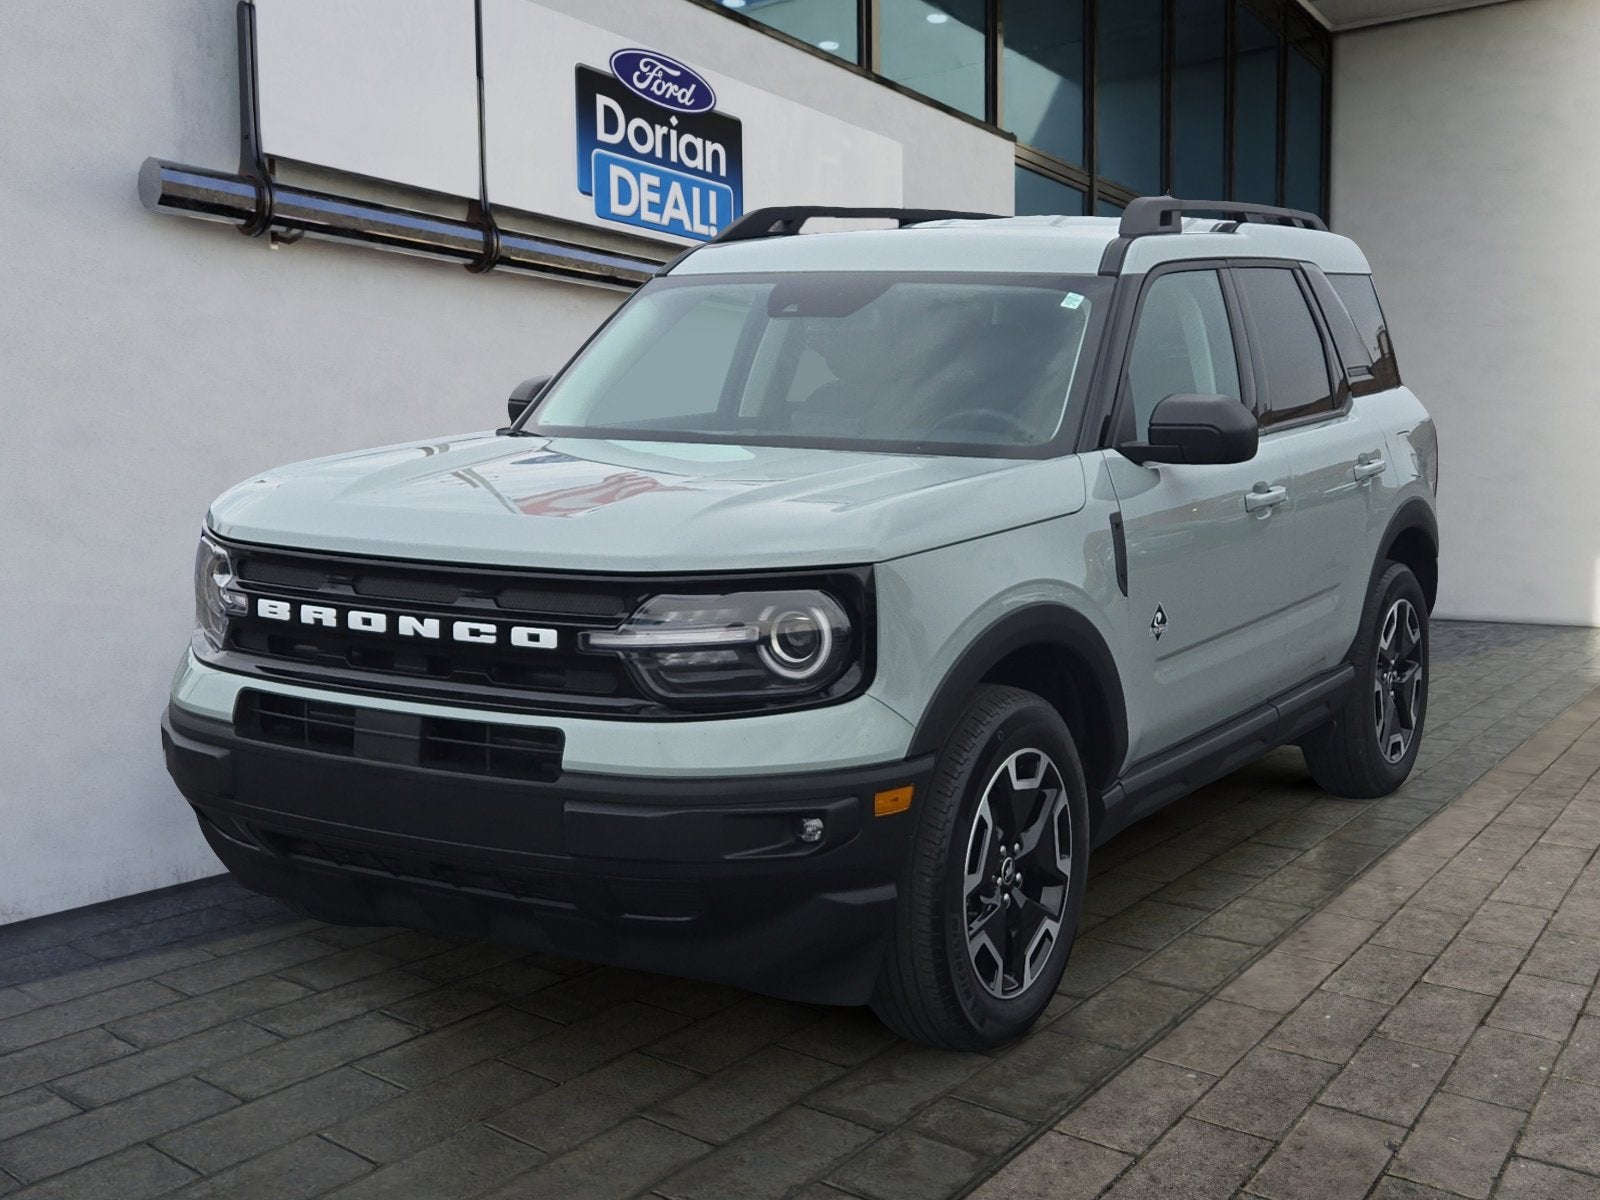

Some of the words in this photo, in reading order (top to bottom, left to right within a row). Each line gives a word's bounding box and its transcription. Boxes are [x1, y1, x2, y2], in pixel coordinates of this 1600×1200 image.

[632, 57, 698, 106] Ford
[595, 92, 727, 178] Dorian
[609, 163, 719, 238] DEAL!
[256, 597, 558, 649] BRONCO
